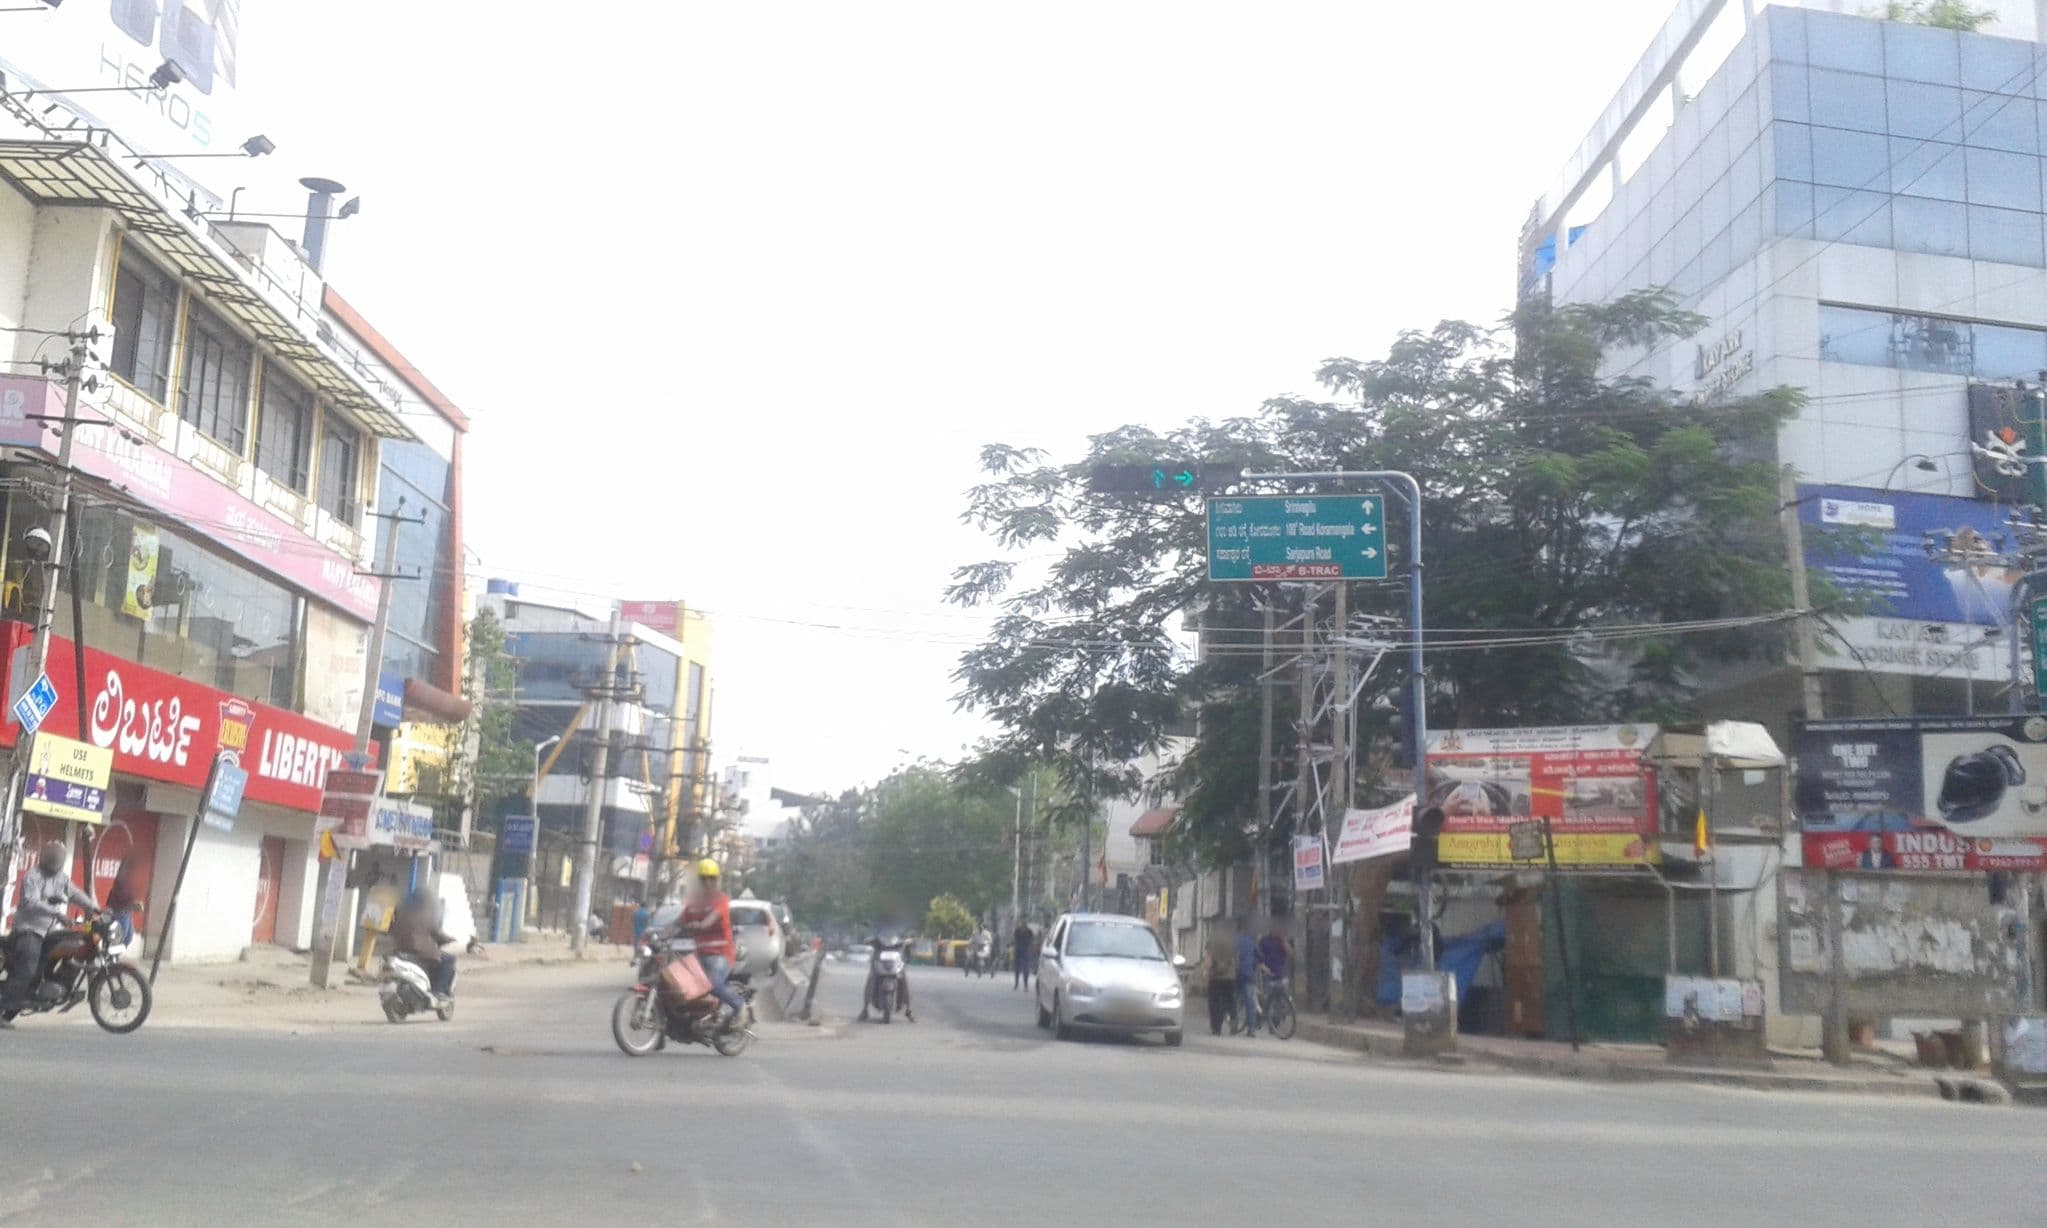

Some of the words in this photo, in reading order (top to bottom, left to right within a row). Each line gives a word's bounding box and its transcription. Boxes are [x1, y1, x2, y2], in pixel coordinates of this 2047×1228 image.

[1298, 565, 1340, 576] B-TRAC
[72, 748, 88, 762] USE
[258, 728, 343, 790] LIBERTY
[60, 763, 95, 782] HELMETS
